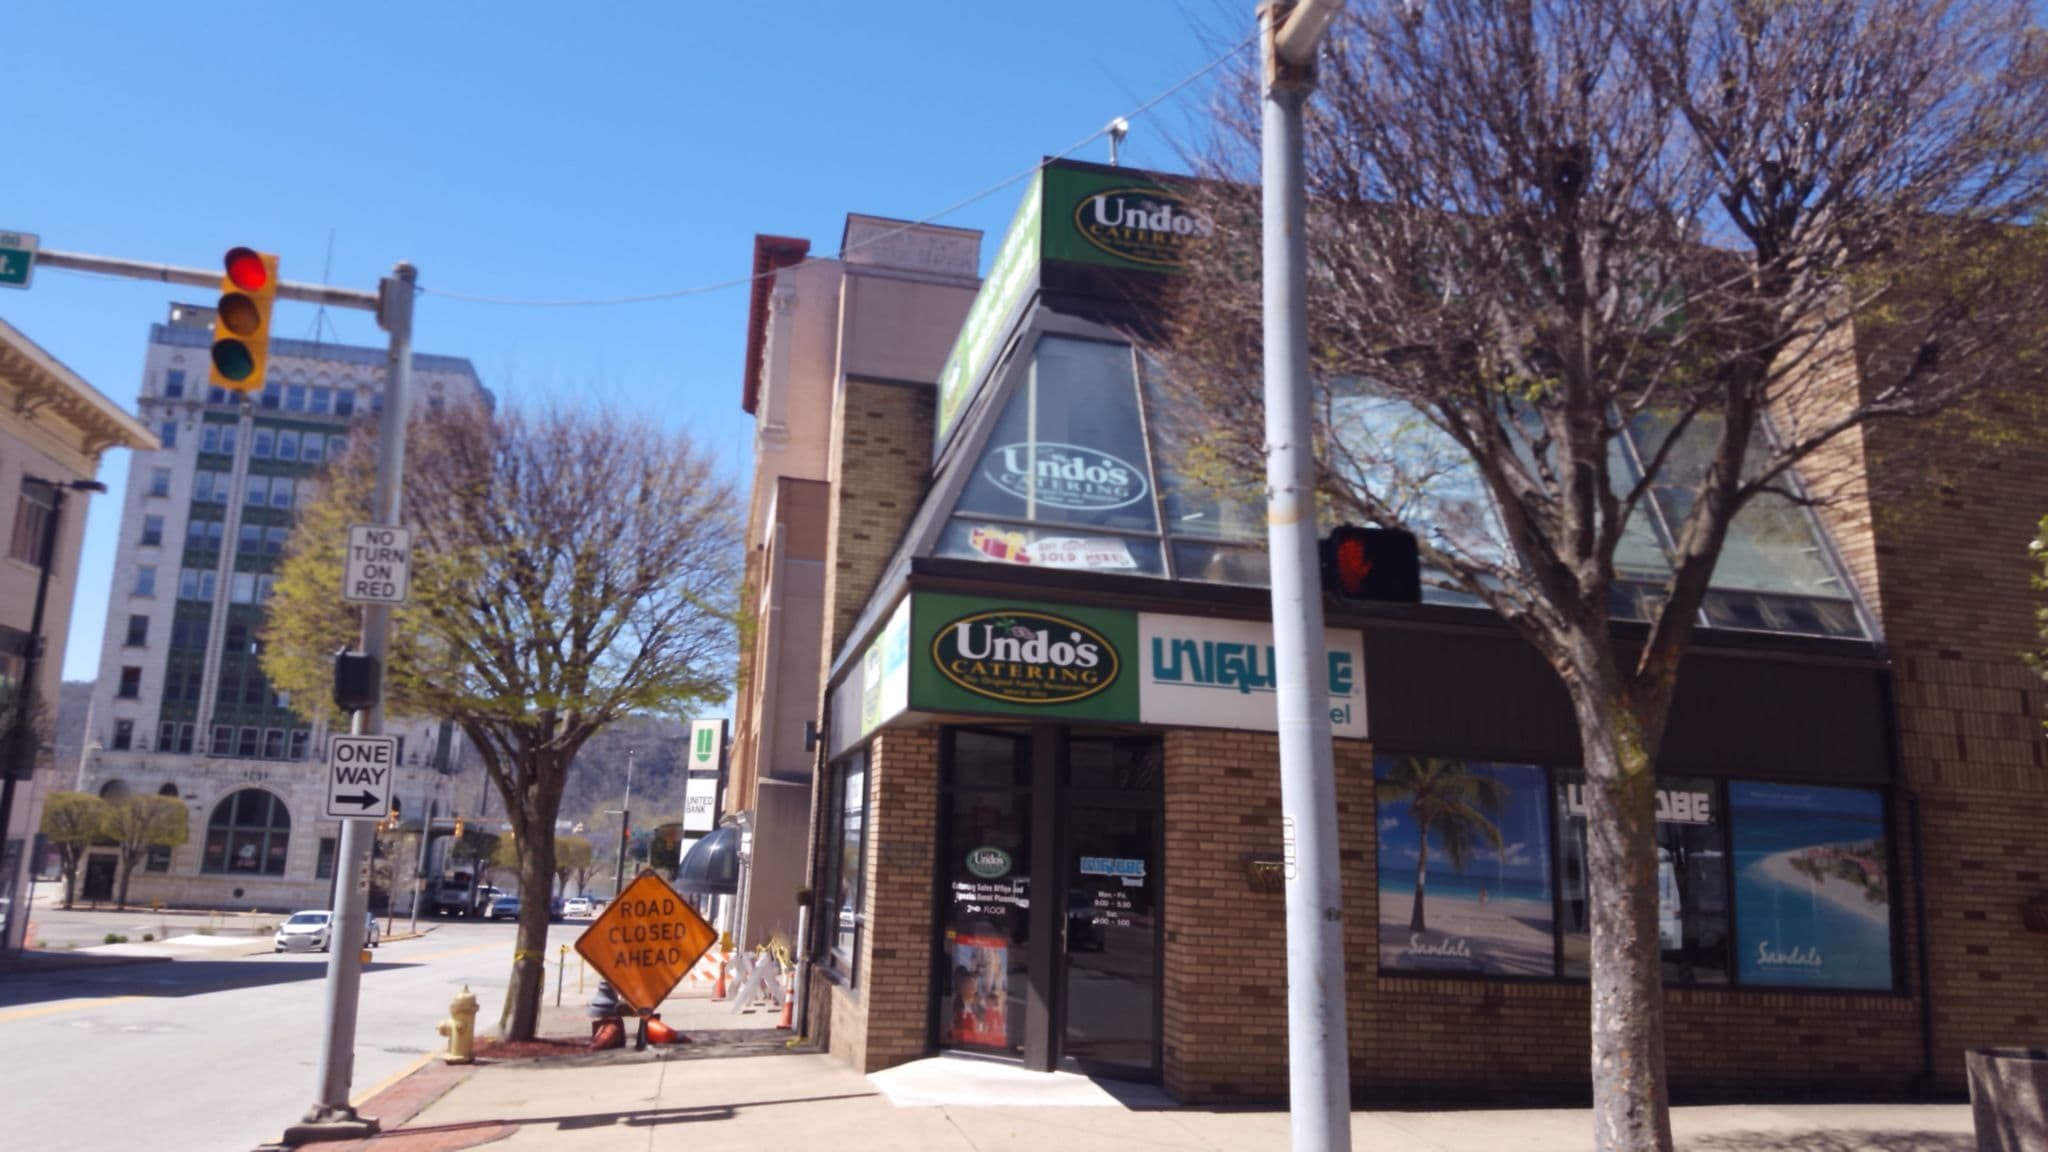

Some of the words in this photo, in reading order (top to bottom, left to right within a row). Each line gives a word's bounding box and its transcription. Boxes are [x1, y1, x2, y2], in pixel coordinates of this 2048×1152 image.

[1094, 195, 1214, 236] Undos
[1004, 449, 1128, 485] Undo's
[366, 531, 394, 545] NO
[354, 546, 404, 563] TURN
[363, 564, 392, 579] ON
[356, 581, 395, 597] RED
[956, 623, 1099, 667] Undo's
[952, 660, 1097, 684] CATERING
[1152, 637, 1352, 694] UNIGLE
[337, 744, 389, 763] ONE
[336, 767, 386, 786] WAY
[686, 805, 705, 813] BANK
[687, 797, 713, 805] UNITED
[620, 899, 675, 918] ROAD
[983, 905, 1006, 914] FLOOR
[608, 922, 686, 944] CLOSED
[1408, 932, 1470, 957] Sandals
[1757, 941, 1822, 966] Sandals
[615, 948, 681, 968] AHEAD
